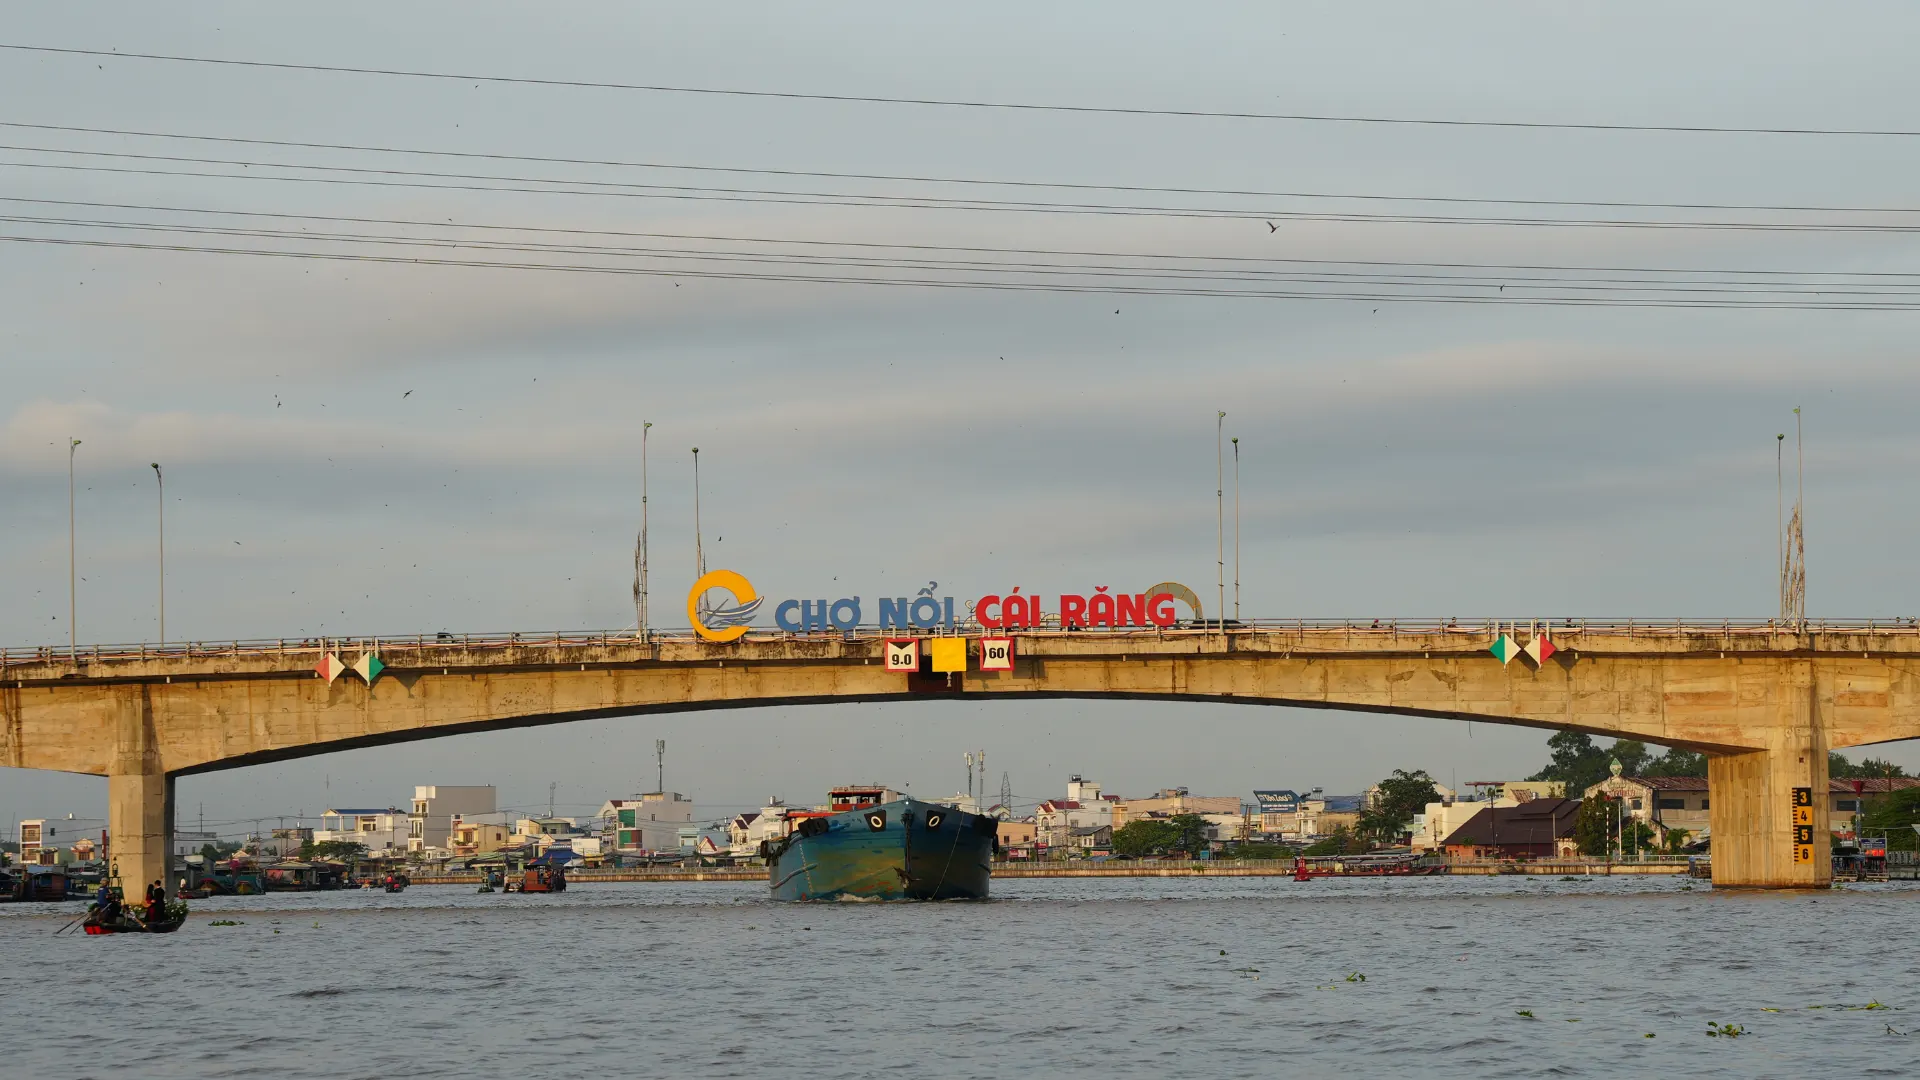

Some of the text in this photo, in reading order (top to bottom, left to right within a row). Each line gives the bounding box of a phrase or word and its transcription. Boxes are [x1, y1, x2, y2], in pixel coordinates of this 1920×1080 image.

[775, 580, 1175, 639] CHỢ NỔI CÁI RĂNG
[988, 647, 1005, 659] 60
[891, 653, 912, 666] 9.0
[1800, 792, 1807, 803] 3
[1801, 811, 1807, 821] 4
[1801, 829, 1808, 841] 5
[1802, 848, 1809, 859] 6
